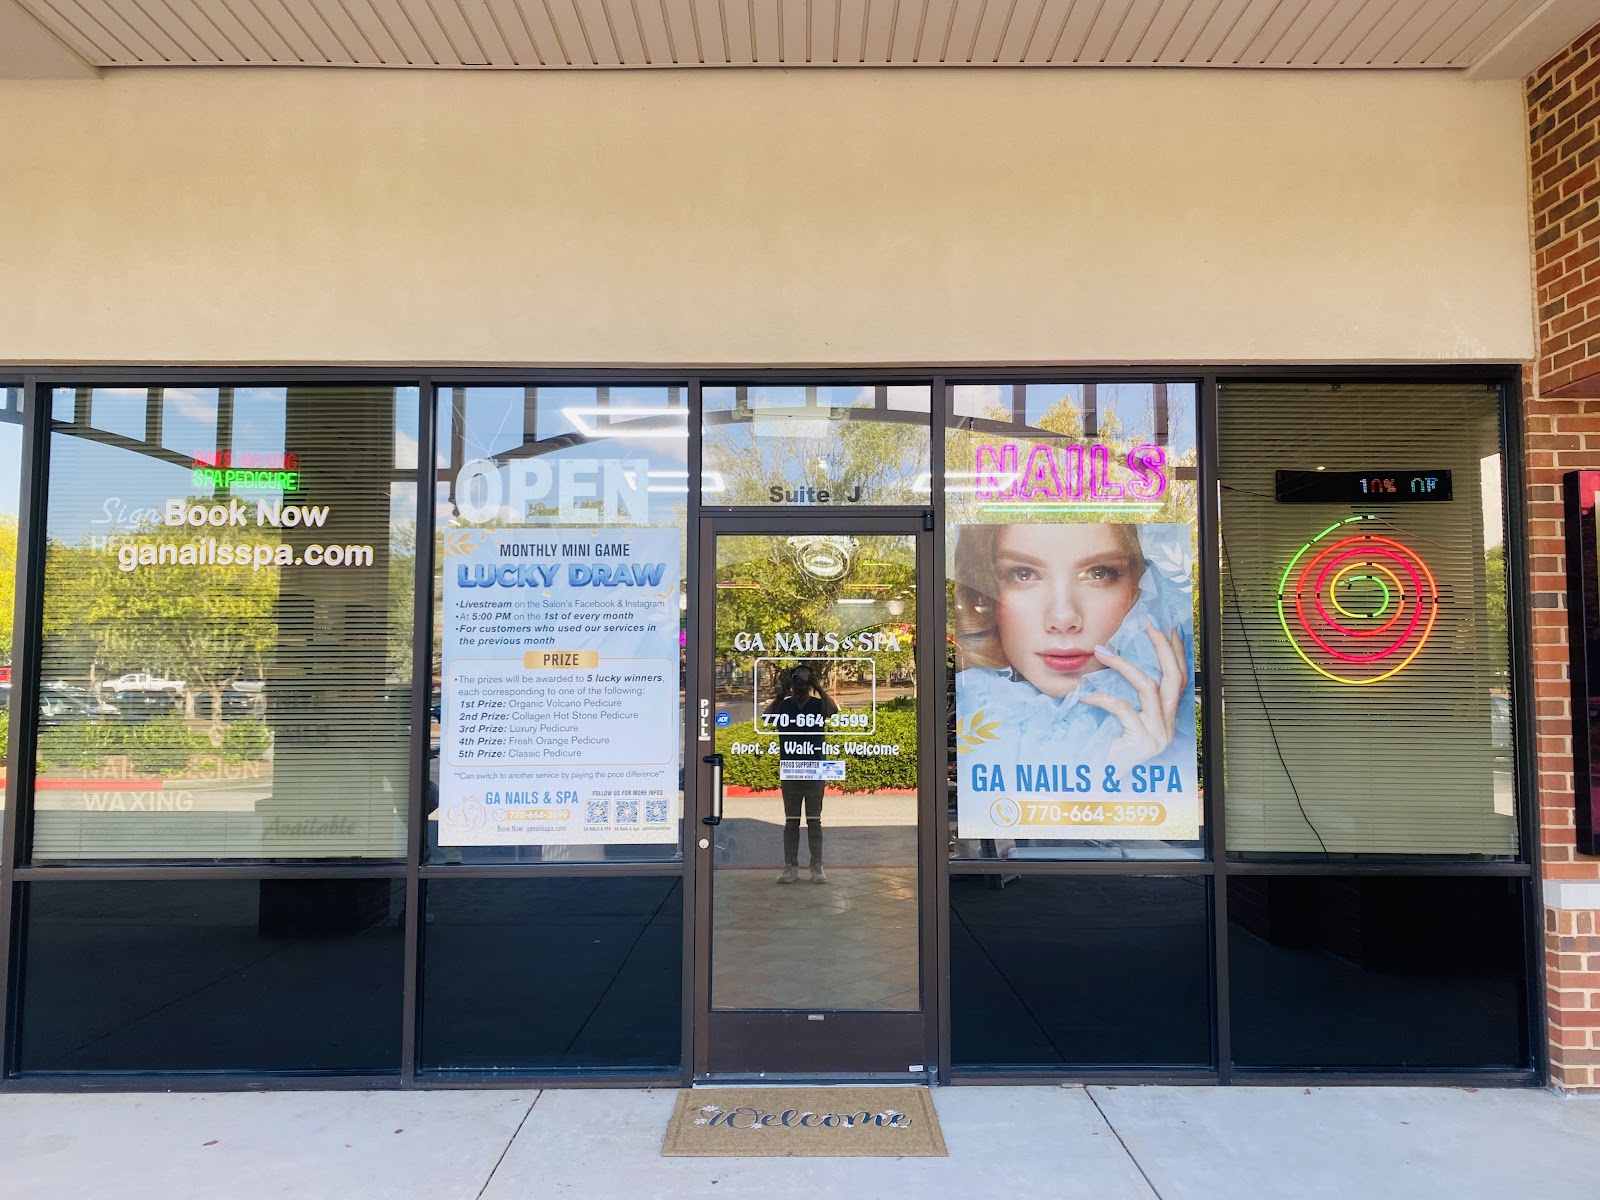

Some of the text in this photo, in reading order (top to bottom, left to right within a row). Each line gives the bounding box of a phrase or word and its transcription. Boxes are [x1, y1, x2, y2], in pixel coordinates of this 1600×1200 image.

[974, 444, 1167, 500] NAILS
[193, 469, 298, 491] SPA PEDICURE
[455, 458, 649, 524] OPEN
[769, 485, 861, 503] Suite J
[164, 499, 330, 528] Book Now
[118, 537, 374, 572] ganailsspa.com
[500, 543, 630, 557] MONTHLY MINI GAME
[457, 562, 667, 588] LUCKY DRAW
[460, 600, 512, 609] Livestream
[527, 600, 541, 608] the
[542, 599, 573, 608] Salon's
[575, 599, 615, 608] Facebook
[617, 600, 623, 608] &
[625, 600, 665, 610] Instagram
[460, 612, 469, 620] At
[472, 612, 492, 620] 5:00
[495, 612, 511, 620] PM
[527, 612, 541, 620] the
[545, 612, 558, 620] 1st
[561, 612, 572, 620] of
[573, 613, 600, 621] every
[602, 612, 634, 620] month
[460, 625, 477, 633] For
[479, 624, 532, 633] customers
[534, 624, 555, 632] who
[557, 624, 582, 632] used
[603, 624, 645, 632] services
[647, 623, 656, 632] in
[459, 637, 555, 646] the previous month
[734, 632, 901, 651] GA NAILS & SPA
[543, 654, 579, 666] PRIZE
[477, 675, 504, 685] prizes
[505, 674, 520, 683] will
[522, 675, 534, 683] be
[535, 674, 573, 683] awarded
[575, 675, 585, 683] to
[586, 674, 593, 682] 5
[595, 674, 622, 683] lucky
[458, 688, 480, 696] each
[482, 687, 545, 697] corresponding
[547, 687, 557, 695] to
[577, 687, 586, 695] of
[588, 686, 602, 695] the
[604, 686, 646, 696] following:
[460, 699, 622, 709] 1st Prize: Organic Volcano Pedicure
[459, 711, 639, 722] 2nd Prize: Collagen Hot Stone Pedicure
[701, 699, 709, 736] PULL
[762, 713, 869, 728] 770-664-3599
[459, 724, 579, 734] 3rd Prize: Luxury Pedicure
[477, 737, 507, 745] Prize:
[508, 737, 533, 745] Fresh
[535, 736, 569, 746] Orange
[571, 736, 610, 744] Pedicure
[731, 741, 899, 755] Appt. & Walk-Ins Welcome
[458, 749, 582, 758] 5th Prize: Classic Pedicure
[475, 772, 498, 780] switch
[561, 771, 570, 780] by
[571, 771, 593, 780] paying
[607, 771, 625, 780] price
[971, 763, 1183, 793] GA NAILS & SPA
[84, 791, 194, 811] WAXING
[485, 791, 579, 805] GA NAILS & SPA
[509, 810, 569, 819] 770-664-3599
[1026, 805, 1160, 822] 770-664-3599
[699, 1107, 912, 1129] Welcome
